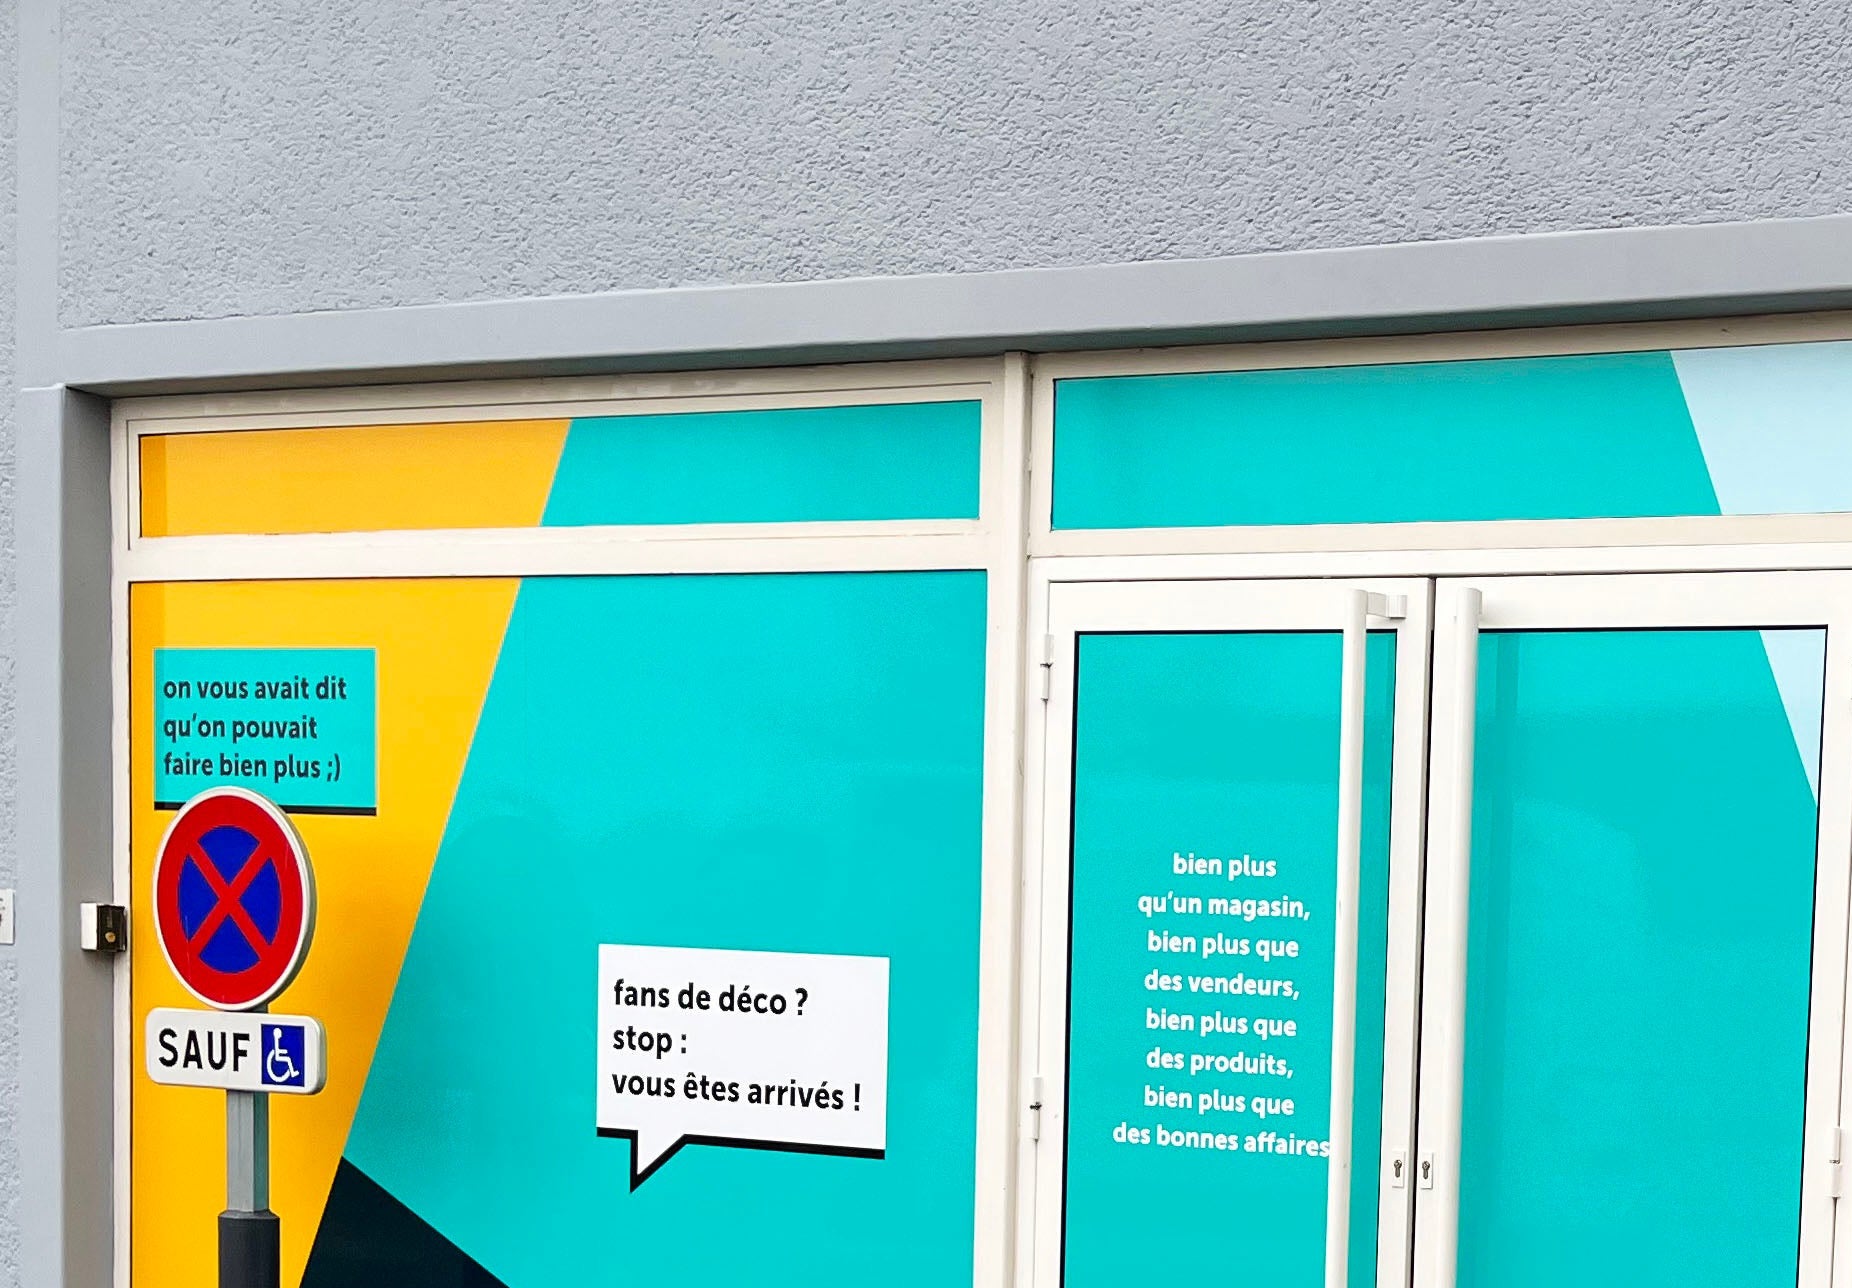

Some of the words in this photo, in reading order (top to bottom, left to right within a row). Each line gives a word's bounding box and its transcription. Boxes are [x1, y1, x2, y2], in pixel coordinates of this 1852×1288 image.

[162, 680, 191, 699] on
[196, 681, 249, 700] vous
[254, 675, 310, 700] avait
[315, 675, 347, 700] dit
[163, 712, 226, 744] qu'on
[232, 714, 318, 745] pouvait
[163, 751, 214, 777] faire
[219, 752, 267, 777] bien
[274, 753, 321, 784] plus
[326, 753, 341, 782] ;)
[1173, 852, 1223, 876] bien
[1228, 854, 1277, 881] plus
[1137, 890, 1203, 918] qu'un
[1208, 895, 1311, 922] magasin,
[1147, 929, 1197, 953] bien
[1202, 932, 1251, 959] plus
[1255, 939, 1299, 962] que
[613, 978, 670, 1009] fans
[677, 982, 711, 1011] de
[718, 984, 787, 1015] déco
[794, 987, 809, 1016] ?
[1144, 968, 1183, 992] des
[1187, 972, 1300, 1001] vendeurs,
[1145, 1007, 1195, 1031] bien
[1200, 1010, 1249, 1037] plus
[1252, 1018, 1297, 1041] que
[158, 1028, 250, 1072] SAUF
[612, 1025, 673, 1060] stop
[1146, 1046, 1185, 1070] des
[1190, 1051, 1293, 1079] produits,
[611, 1073, 676, 1098] vous
[683, 1071, 740, 1103] êtes
[747, 1078, 844, 1110] arrivés
[854, 1083, 861, 1112] !
[1144, 1084, 1193, 1109] bien
[1198, 1088, 1246, 1115] plus
[1250, 1096, 1295, 1119] que
[1112, 1121, 1151, 1145] des
[1156, 1123, 1239, 1151] bonnes
[1243, 1131, 1330, 1158] affaires
